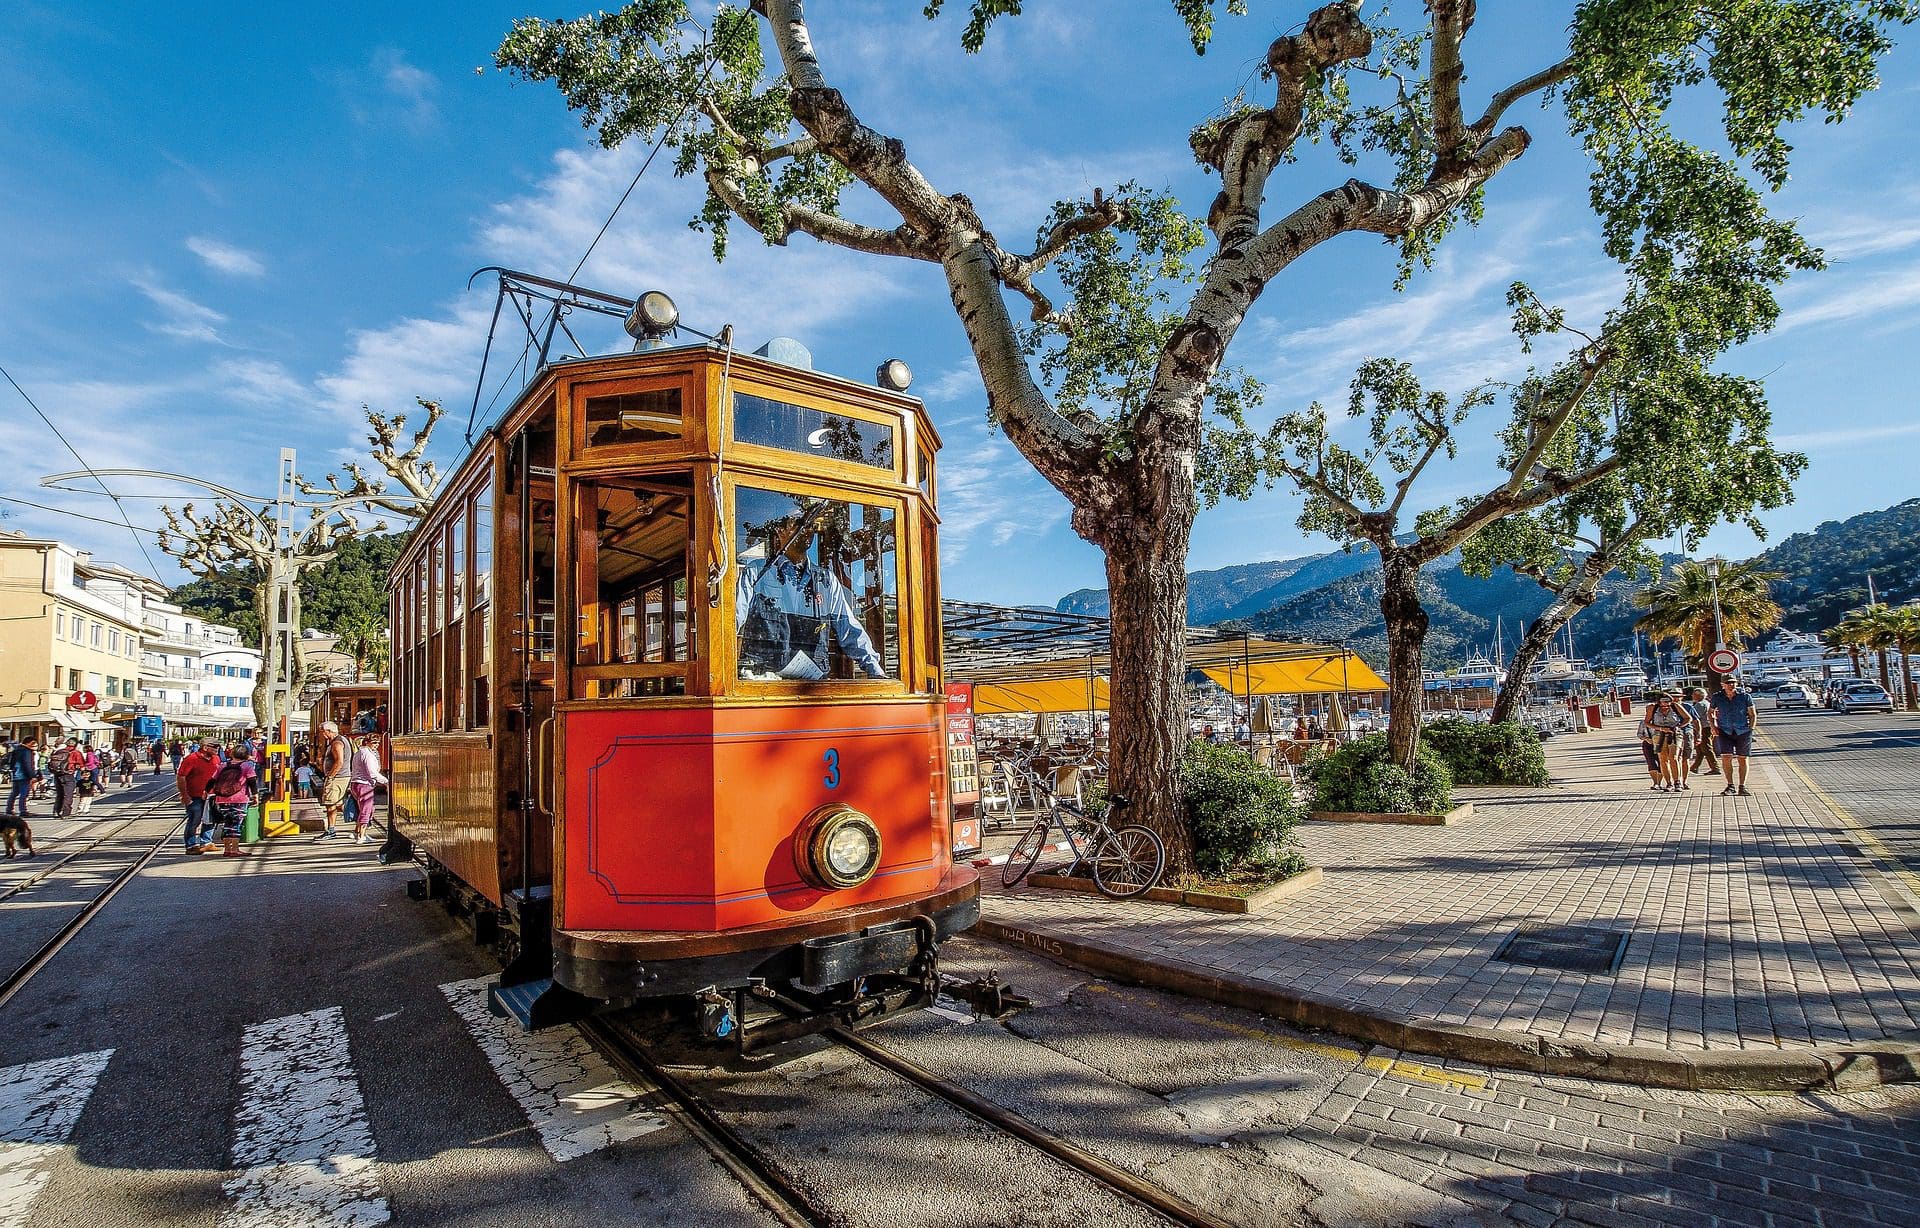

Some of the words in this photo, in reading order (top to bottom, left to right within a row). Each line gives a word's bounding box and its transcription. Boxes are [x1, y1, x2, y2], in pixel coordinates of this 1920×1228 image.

[949, 693, 968, 703] Coca-Cola
[949, 719, 970, 729] Coca-Cola
[823, 747, 840, 790] 3
